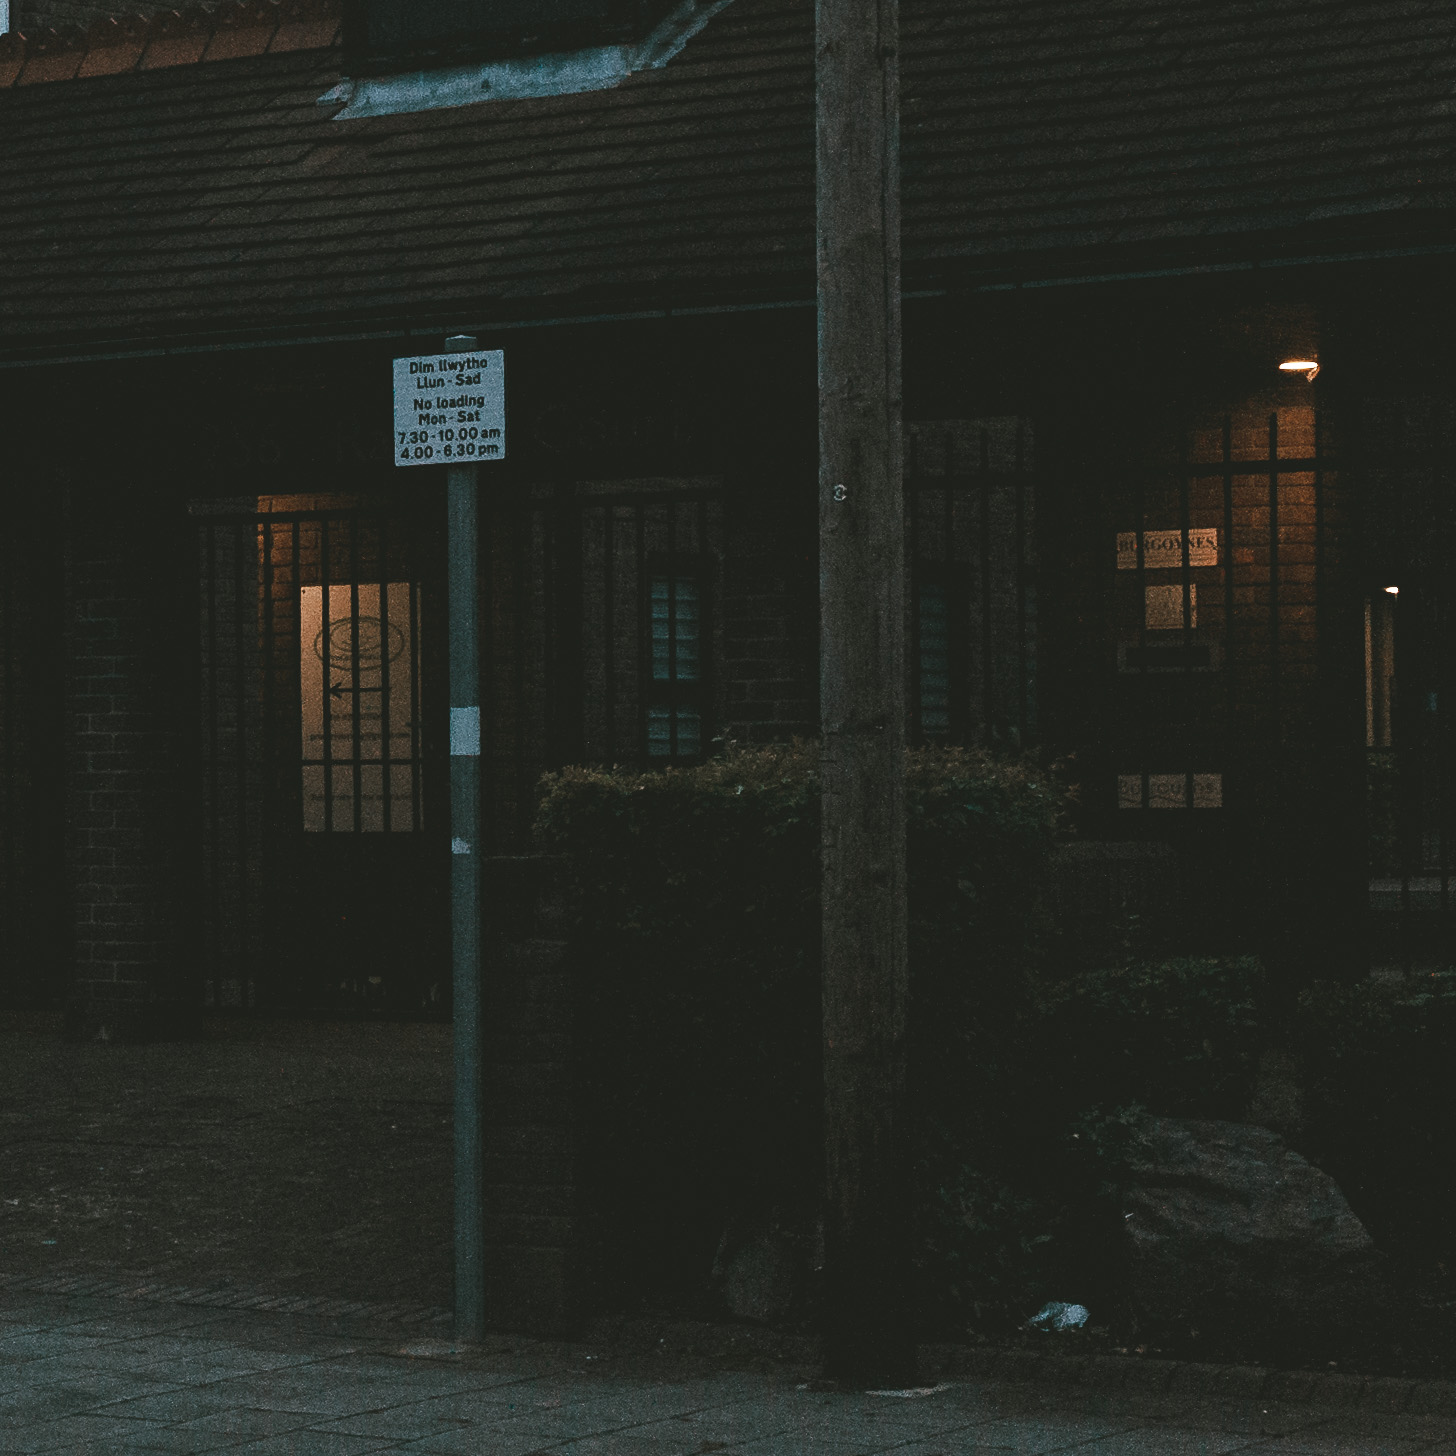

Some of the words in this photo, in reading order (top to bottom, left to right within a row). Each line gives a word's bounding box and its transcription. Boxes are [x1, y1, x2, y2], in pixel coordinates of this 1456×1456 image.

[409, 361, 435, 374] Dim
[439, 357, 488, 372] llwytho
[416, 377, 445, 389] Llun
[455, 372, 481, 386] Sad
[413, 398, 432, 411] No
[436, 395, 485, 409] loading
[418, 413, 447, 425] Mon
[457, 410, 481, 423] Sat
[438, 427, 478, 442] 10.00
[481, 428, 501, 439] am
[400, 446, 433, 460] 4.00
[443, 443, 476, 457] 6.30
[478, 443, 499, 456] pm
